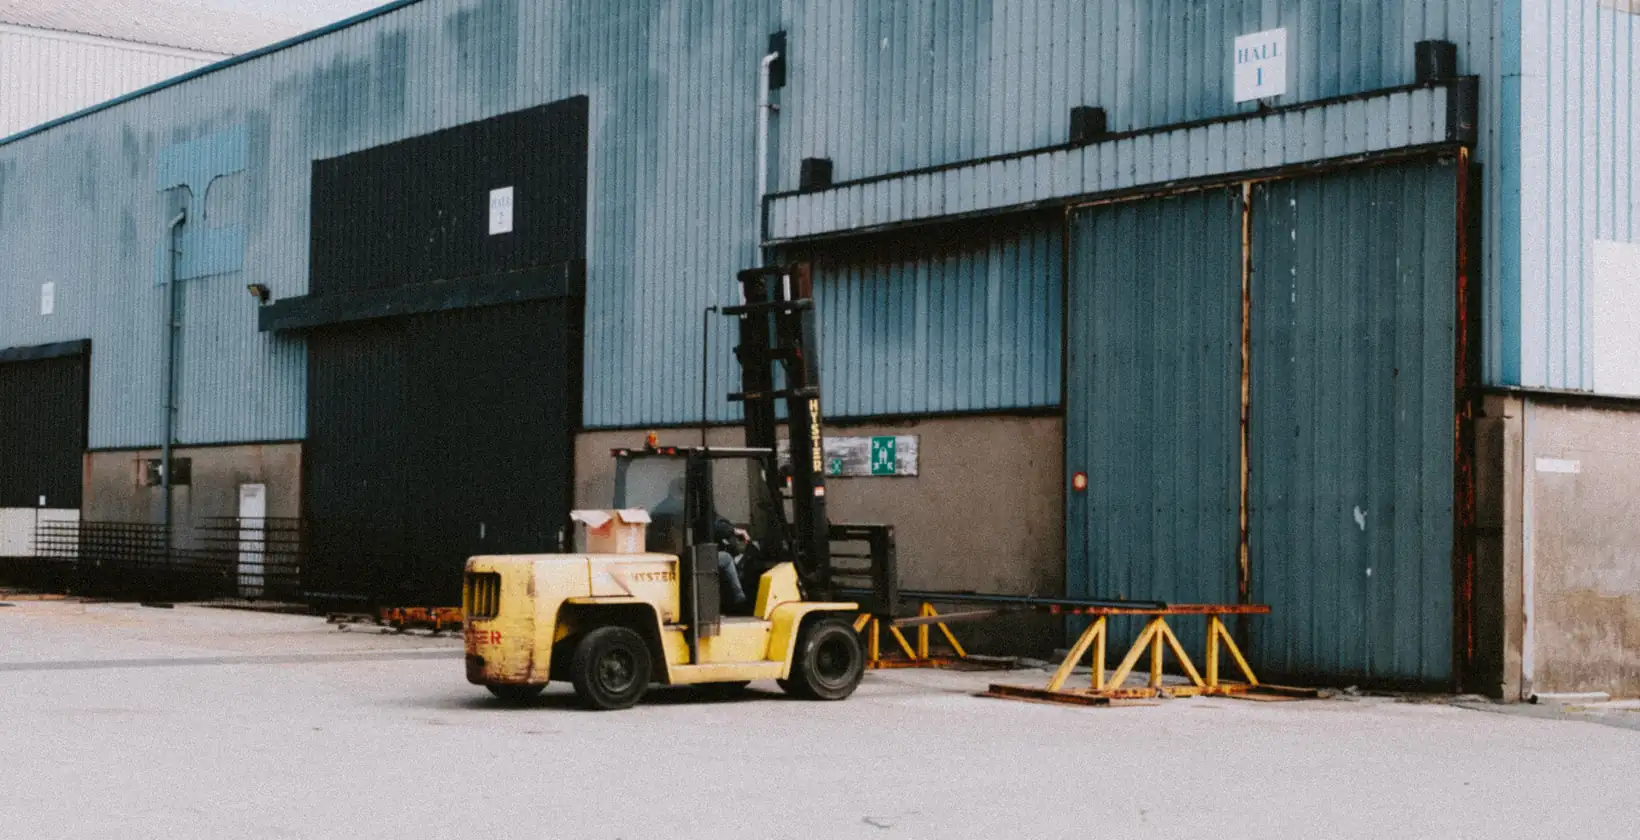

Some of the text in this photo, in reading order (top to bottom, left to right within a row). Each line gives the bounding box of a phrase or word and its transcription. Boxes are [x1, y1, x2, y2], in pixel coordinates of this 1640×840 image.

[1237, 42, 1282, 64] HALL
[808, 399, 822, 472] HYSTER
[631, 571, 676, 582] HYSTER
